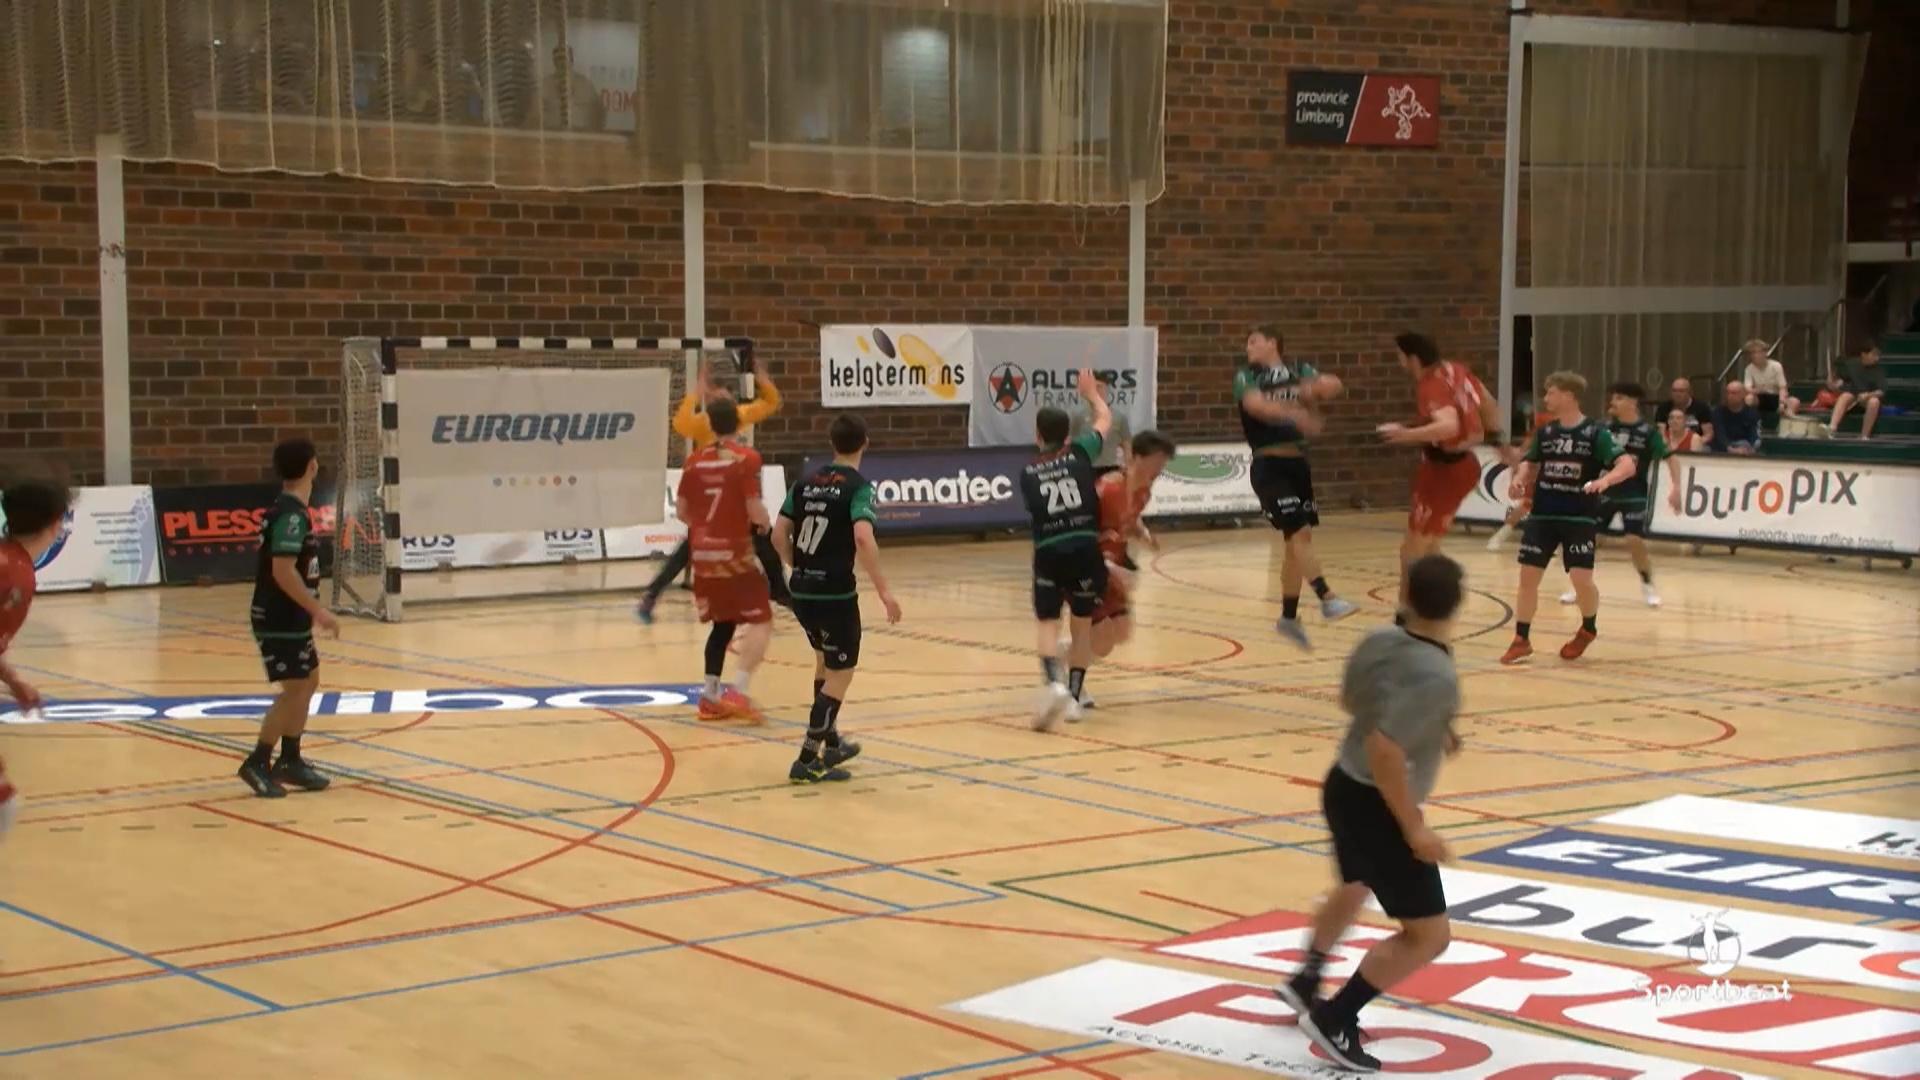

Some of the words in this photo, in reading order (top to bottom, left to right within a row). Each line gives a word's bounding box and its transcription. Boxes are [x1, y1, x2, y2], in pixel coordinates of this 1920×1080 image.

[1296, 91, 1349, 106] provincie
[1296, 108, 1344, 128] Limburg
[1031, 368, 1137, 389] ALDRS
[431, 412, 635, 445] EUROQUIP
[871, 469, 1013, 504] omatec
[1040, 477, 1083, 515] 26
[1685, 466, 1860, 519] buropix
[704, 488, 723, 522] 7
[1505, 839, 1920, 908] EUR
